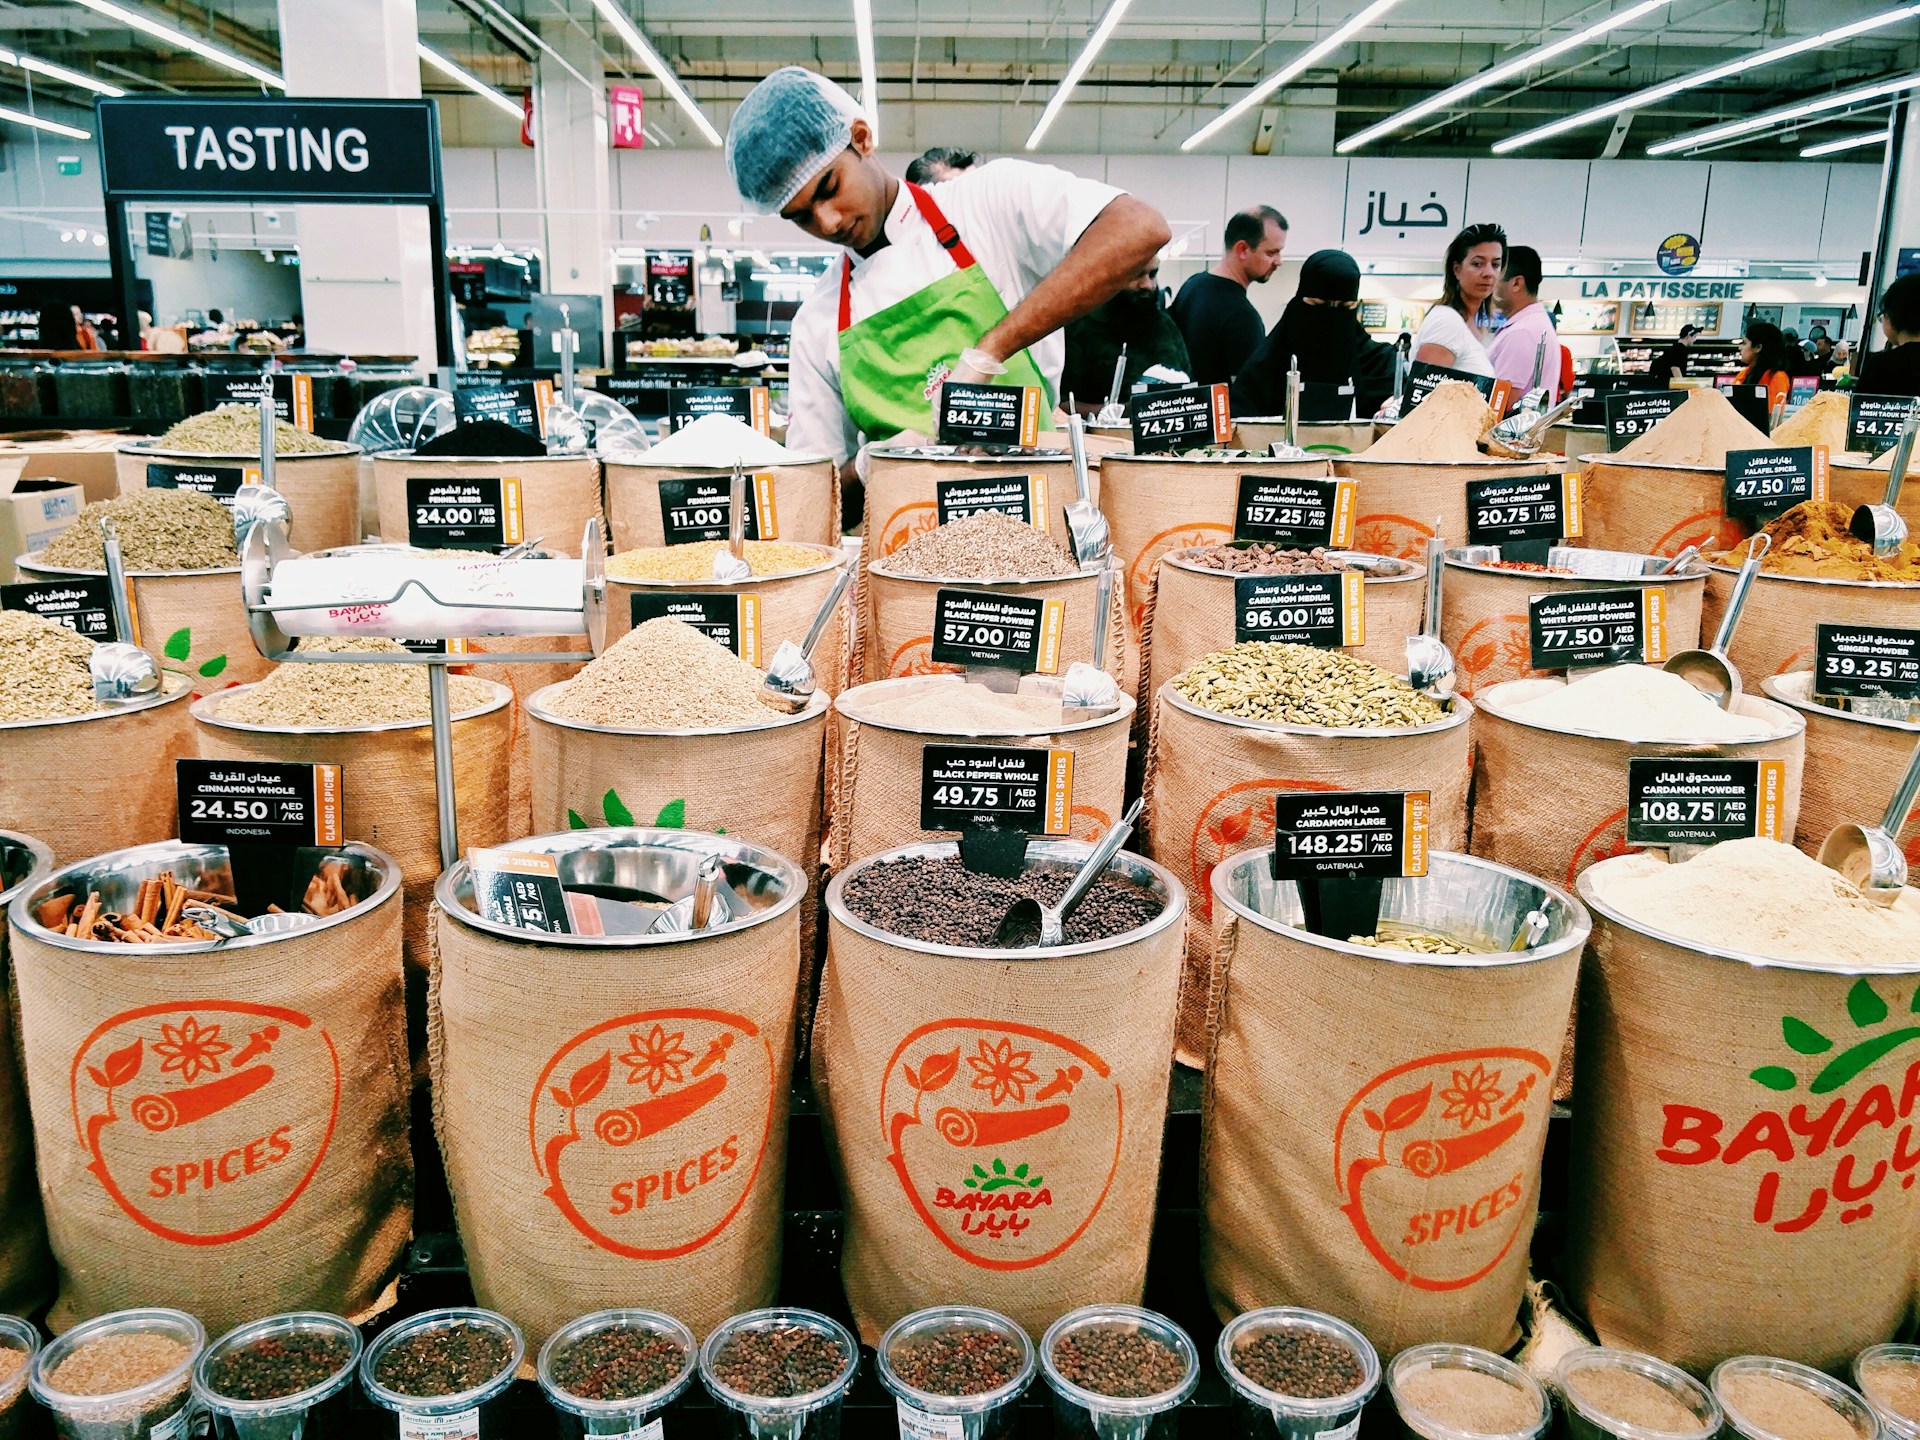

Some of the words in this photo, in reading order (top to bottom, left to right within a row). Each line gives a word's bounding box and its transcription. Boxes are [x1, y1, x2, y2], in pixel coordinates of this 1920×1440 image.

[165, 126, 370, 173] TASTING
[1359, 191, 1448, 239] خباز
[1581, 281, 1610, 298] LA
[1618, 281, 1745, 300] PATISSERIE
[1626, 402, 1645, 411] مندي
[947, 410, 993, 425] 84.75
[1001, 412, 1016, 420] AED
[1193, 413, 1207, 422] AED
[1140, 417, 1184, 435] 74.75
[1194, 421, 1208, 429] /KG
[1856, 420, 1904, 436] 54.75
[1748, 458, 1769, 467] فلافل
[1770, 456, 1793, 466] بهارات
[1745, 467, 1773, 476] FALAFEL
[1773, 465, 1797, 474] SPICES
[1791, 477, 1806, 485] AED
[429, 485, 460, 496] الشومر
[462, 486, 480, 496] بذور
[697, 487, 717, 495] حلبة
[1735, 478, 1784, 496] 47.50
[1791, 485, 1806, 493] /KG
[687, 495, 730, 505] FENUGREEK
[944, 497, 967, 506] BLACK
[968, 496, 992, 504] PEPPER
[993, 494, 1024, 503] CRUSHED
[1253, 495, 1295, 504] CARDAMOM
[1296, 498, 1322, 506] BLACK
[1488, 496, 1507, 504] CHILI
[1509, 494, 1544, 503] CRUSHED
[1006, 506, 1023, 514] AED
[1539, 504, 1555, 512] AED
[416, 508, 473, 524] 24.00
[480, 516, 496, 524] /KG
[670, 508, 722, 526] 11.00
[1246, 507, 1302, 525] 157.25
[1477, 505, 1530, 526] 20.75
[1540, 512, 1556, 521] /KG
[1308, 518, 1325, 526] /KG
[704, 529, 721, 537] INDIA
[945, 599, 972, 611] الأسود
[1248, 595, 1297, 605] CARDAMOM
[1297, 594, 1330, 602] MEDIUM
[36, 601, 80, 612] OREGANO
[973, 603, 1000, 614] الفلفل
[1315, 607, 1334, 616] AED
[1539, 604, 1568, 616] الأبيض
[1569, 603, 1597, 613] الفلفل
[1598, 601, 1635, 611] مسحوق
[86, 612, 107, 622] AED
[1001, 607, 1036, 618] مسحوق
[1245, 608, 1308, 628] 96.00
[1539, 616, 1566, 625] WHITE
[1567, 614, 1598, 623] PEPPER
[1599, 611, 1636, 621] POWDER
[944, 610, 970, 620] BLACK
[971, 614, 1000, 623] PEPPER
[1001, 617, 1035, 627] POWDER
[1316, 616, 1334, 625] /KG
[90, 621, 108, 631] /KG
[712, 627, 731, 635] AED
[1615, 625, 1634, 634] AED
[943, 624, 1005, 646] 57.00
[1012, 631, 1032, 640] AED
[1270, 633, 1310, 641] GUATEMALA
[1541, 627, 1604, 648] 77.50
[1616, 634, 1635, 643] /KG
[1831, 632, 1873, 645] الزنجبيل
[1012, 639, 1031, 648] /KG
[1875, 637, 1916, 647] مسحوق
[971, 651, 1001, 660] VIETNAM
[1573, 651, 1604, 660] VIETNAM
[1837, 645, 1870, 654] GINGER
[1871, 646, 1910, 656] POWDER
[1826, 658, 1893, 677] 39.25
[1899, 662, 1919, 670] AED
[1901, 670, 1919, 679] /KG
[1860, 683, 1882, 691] CHINA
[947, 759, 968, 768] حب
[969, 758, 996, 769] أسود
[998, 758, 1025, 768] فلفل
[210, 771, 247, 783] القرفة
[249, 773, 282, 783] عيدان
[933, 770, 961, 779] BLACK
[962, 771, 1002, 780] PEPPER
[1003, 772, 1039, 782] WHOLE
[1056, 756, 1067, 791] SPICES
[1656, 772, 1684, 784] الهال
[1687, 773, 1731, 785] مسحوق
[198, 785, 256, 795] CINNAMON
[257, 786, 295, 796] WHOLE
[324, 768, 336, 803] SPICES
[1643, 786, 1701, 795] CARDAMOM
[1702, 786, 1746, 795] POWDER
[933, 786, 999, 806] 49.75
[1015, 788, 1037, 798] AED
[281, 802, 304, 812] AED
[1015, 797, 1036, 808] /KG
[1724, 802, 1746, 811] AED
[191, 800, 268, 819] 24.50
[1054, 793, 1064, 830] CLASSIC
[1302, 806, 1329, 818] كبير
[1330, 805, 1359, 816] الهال
[1360, 804, 1380, 814] حب
[1640, 802, 1715, 822] 108.75
[282, 811, 304, 822] /KG
[973, 815, 995, 823] INDIA
[1413, 799, 1425, 833] SPICES
[1725, 811, 1746, 822] /KG
[325, 805, 336, 843] CLASSIC
[1296, 818, 1352, 828] CARDAMOM
[1354, 817, 1387, 826] LARGE
[226, 828, 271, 836] INDONESIA
[1371, 832, 1393, 842] AED
[1668, 831, 1716, 839] GUATEMALA
[1288, 834, 1364, 855] 148.25
[1374, 842, 1393, 853] /KG
[1412, 834, 1422, 874] CLASSIC
[1316, 862, 1365, 871] GUATEMALA
[516, 881, 528, 900] AED
[526, 882, 539, 901] /KG
[503, 895, 517, 927] WHOLE
[148, 1125, 292, 1198] SPICES
[609, 1134, 739, 1216] SPICES
[933, 1187, 1053, 1212] BAYARA
[1402, 1172, 1523, 1247] SPICES
[402, 1414, 431, 1424] Carrefour
